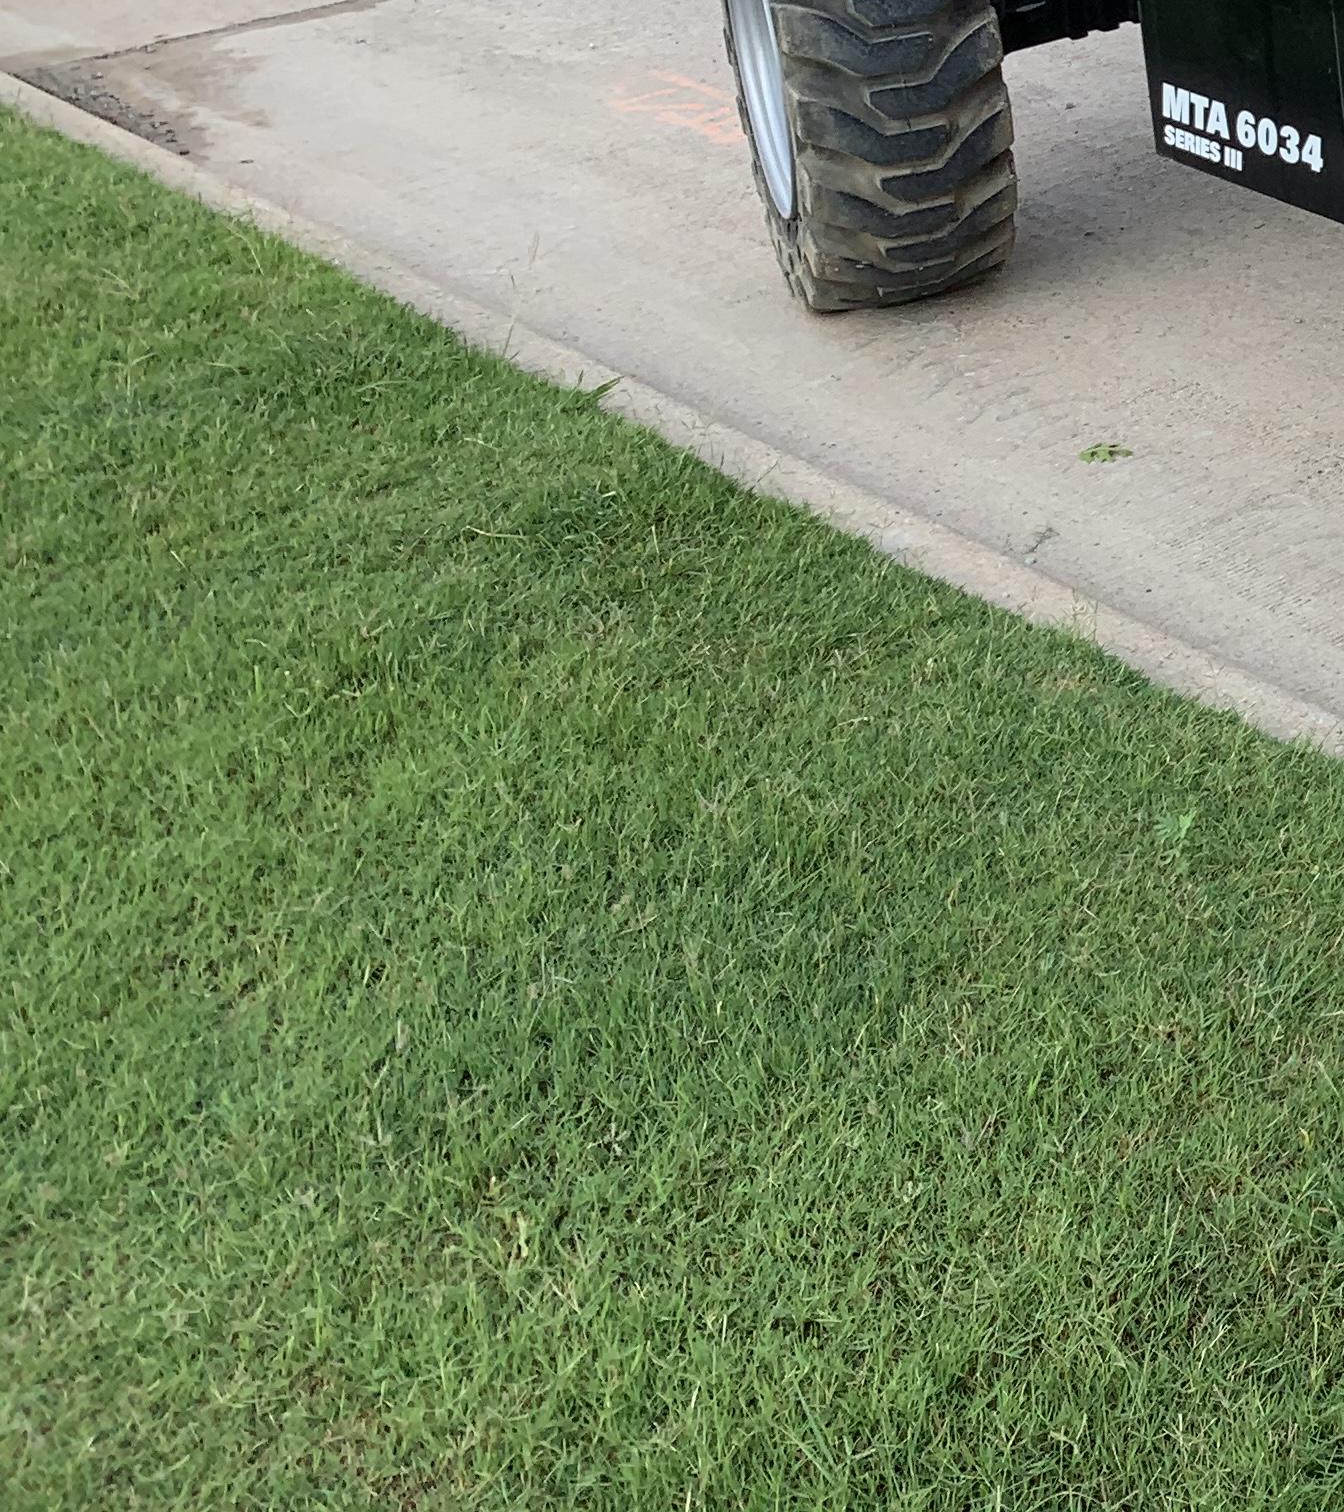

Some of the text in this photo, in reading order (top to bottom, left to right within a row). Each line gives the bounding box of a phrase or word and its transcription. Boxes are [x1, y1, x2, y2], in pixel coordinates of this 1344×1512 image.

[1162, 82, 1323, 173] MTA 6034
[1164, 124, 1243, 171] SERIES III
